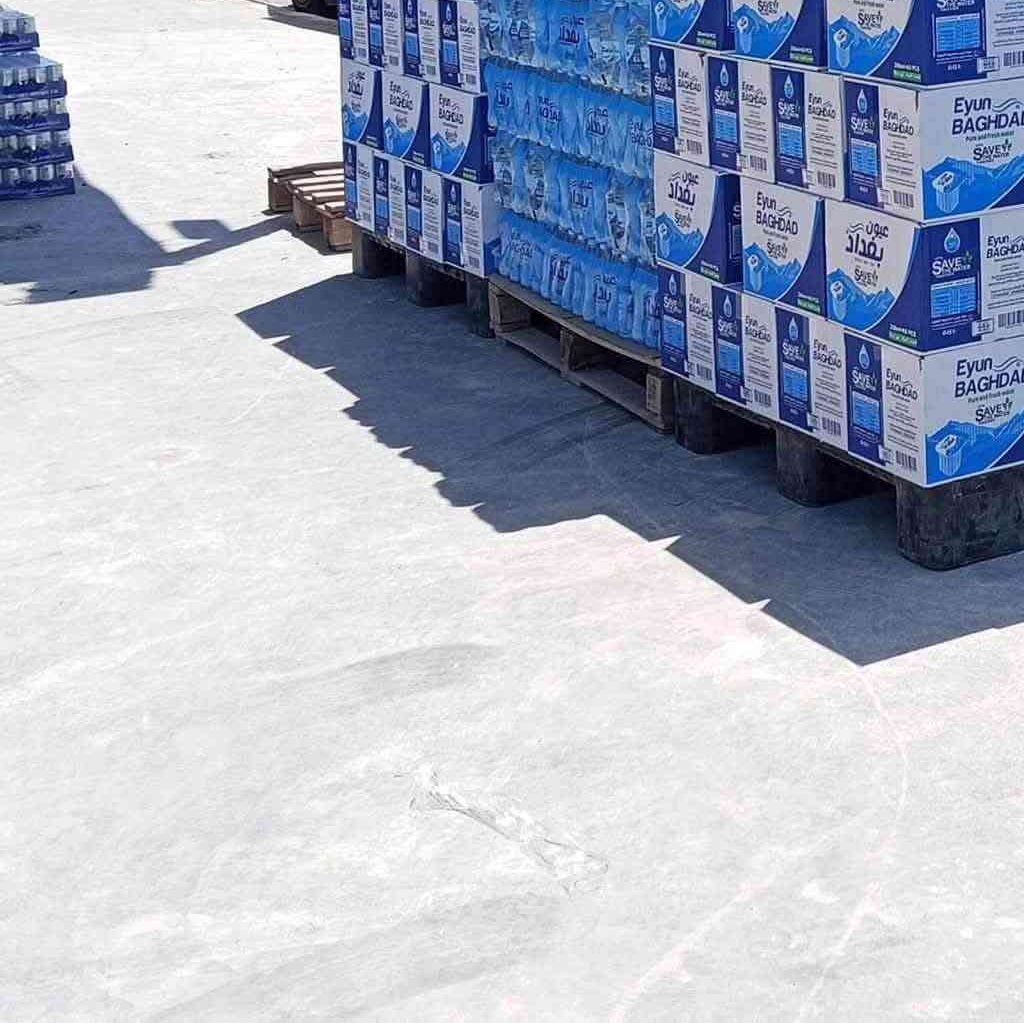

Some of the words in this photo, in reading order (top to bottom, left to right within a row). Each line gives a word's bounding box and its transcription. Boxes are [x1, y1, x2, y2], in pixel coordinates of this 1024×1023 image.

[954, 97, 991, 116] Eyun
[973, 144, 1002, 161] SAVE
[668, 180, 696, 210] بغداد
[757, 192, 776, 210] Eyun
[756, 211, 798, 235] BAGHDAD
[866, 220, 888, 239] عيون
[846, 233, 884, 268] بغداد
[988, 235, 1009, 247] Eyun
[932, 256, 962, 276] SAVE
[956, 358, 992, 378] Eyun
[886, 380, 918, 400] BAGHDAD
[976, 404, 1003, 422] SAVE
